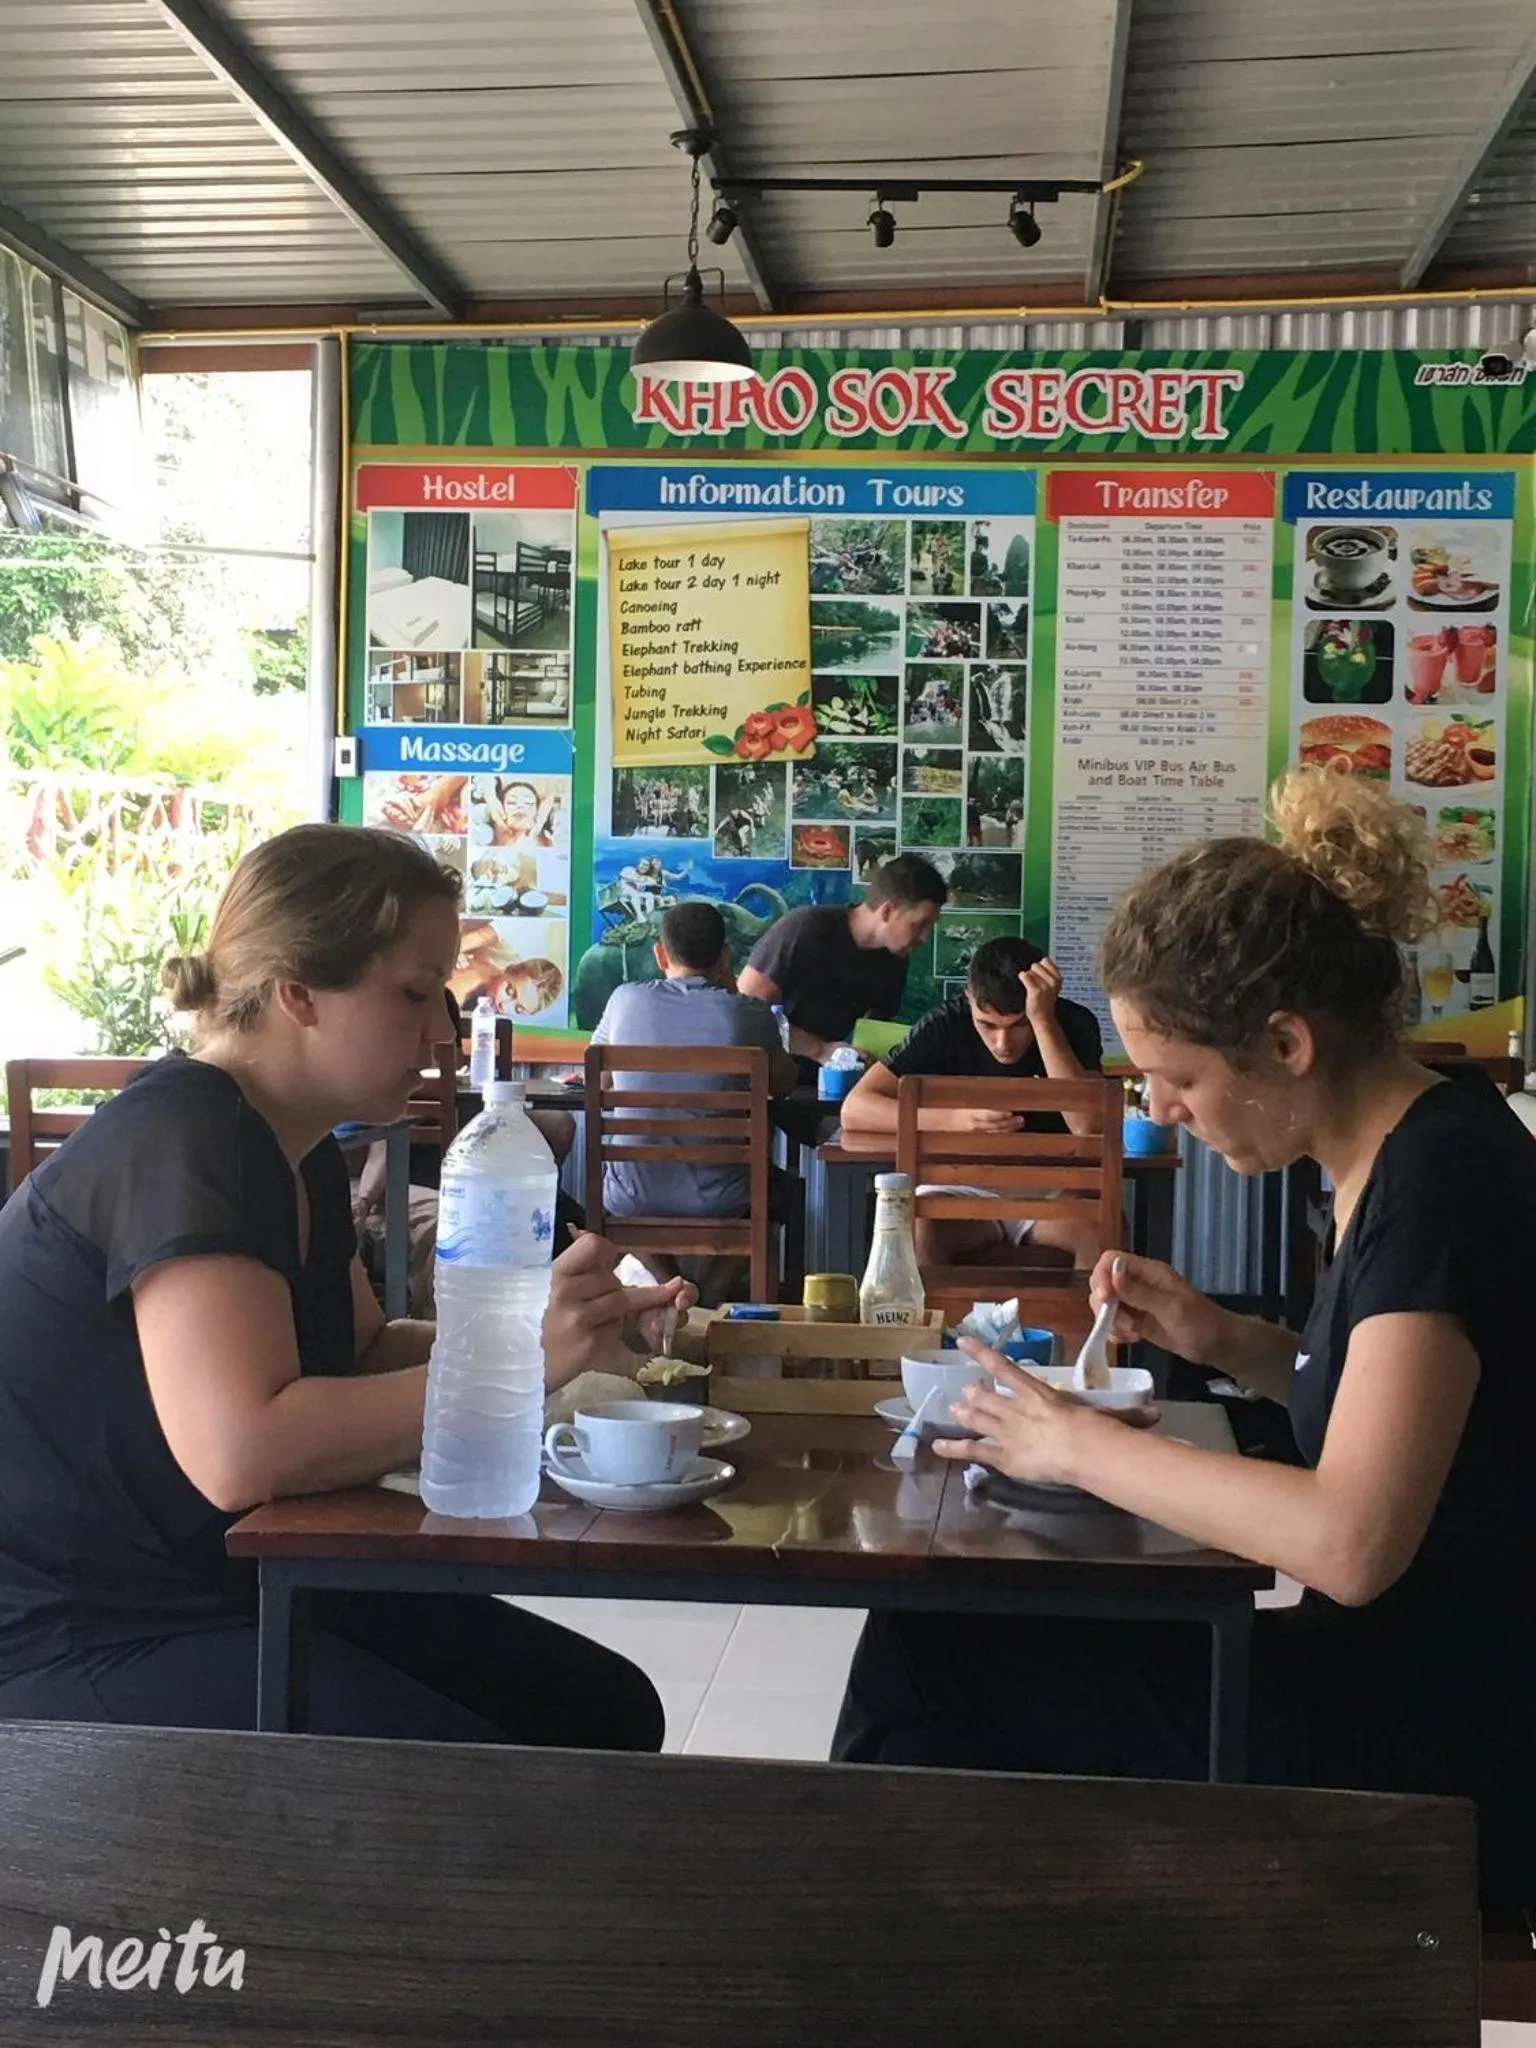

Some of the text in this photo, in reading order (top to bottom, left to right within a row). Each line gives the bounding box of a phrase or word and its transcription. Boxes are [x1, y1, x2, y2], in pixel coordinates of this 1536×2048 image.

[635, 367, 1243, 440] KHAO SOK SECRET
[423, 474, 514, 501] Hostel
[661, 475, 964, 507] Information Tours
[1095, 479, 1228, 509] Transfer
[1307, 481, 1492, 510] Restaurants
[619, 553, 725, 571] Lake tour 1 day
[620, 571, 781, 592] Lake tour 2 day 1 night
[620, 601, 677, 615] Canoeing
[621, 618, 702, 635] Bamboo raft
[622, 640, 738, 658] Elephant Trekking
[623, 659, 807, 680] Elephant bathing Experience
[624, 685, 666, 701] Tubing
[624, 704, 727, 723] Jungle Trekking
[626, 726, 705, 744] Night Safari
[401, 736, 525, 771] Massage
[1078, 759, 1236, 773] Minibus VIP Bus Air Bus
[1089, 774, 1224, 788] and Boat Time Table
[876, 1312, 910, 1325] HEINZ
